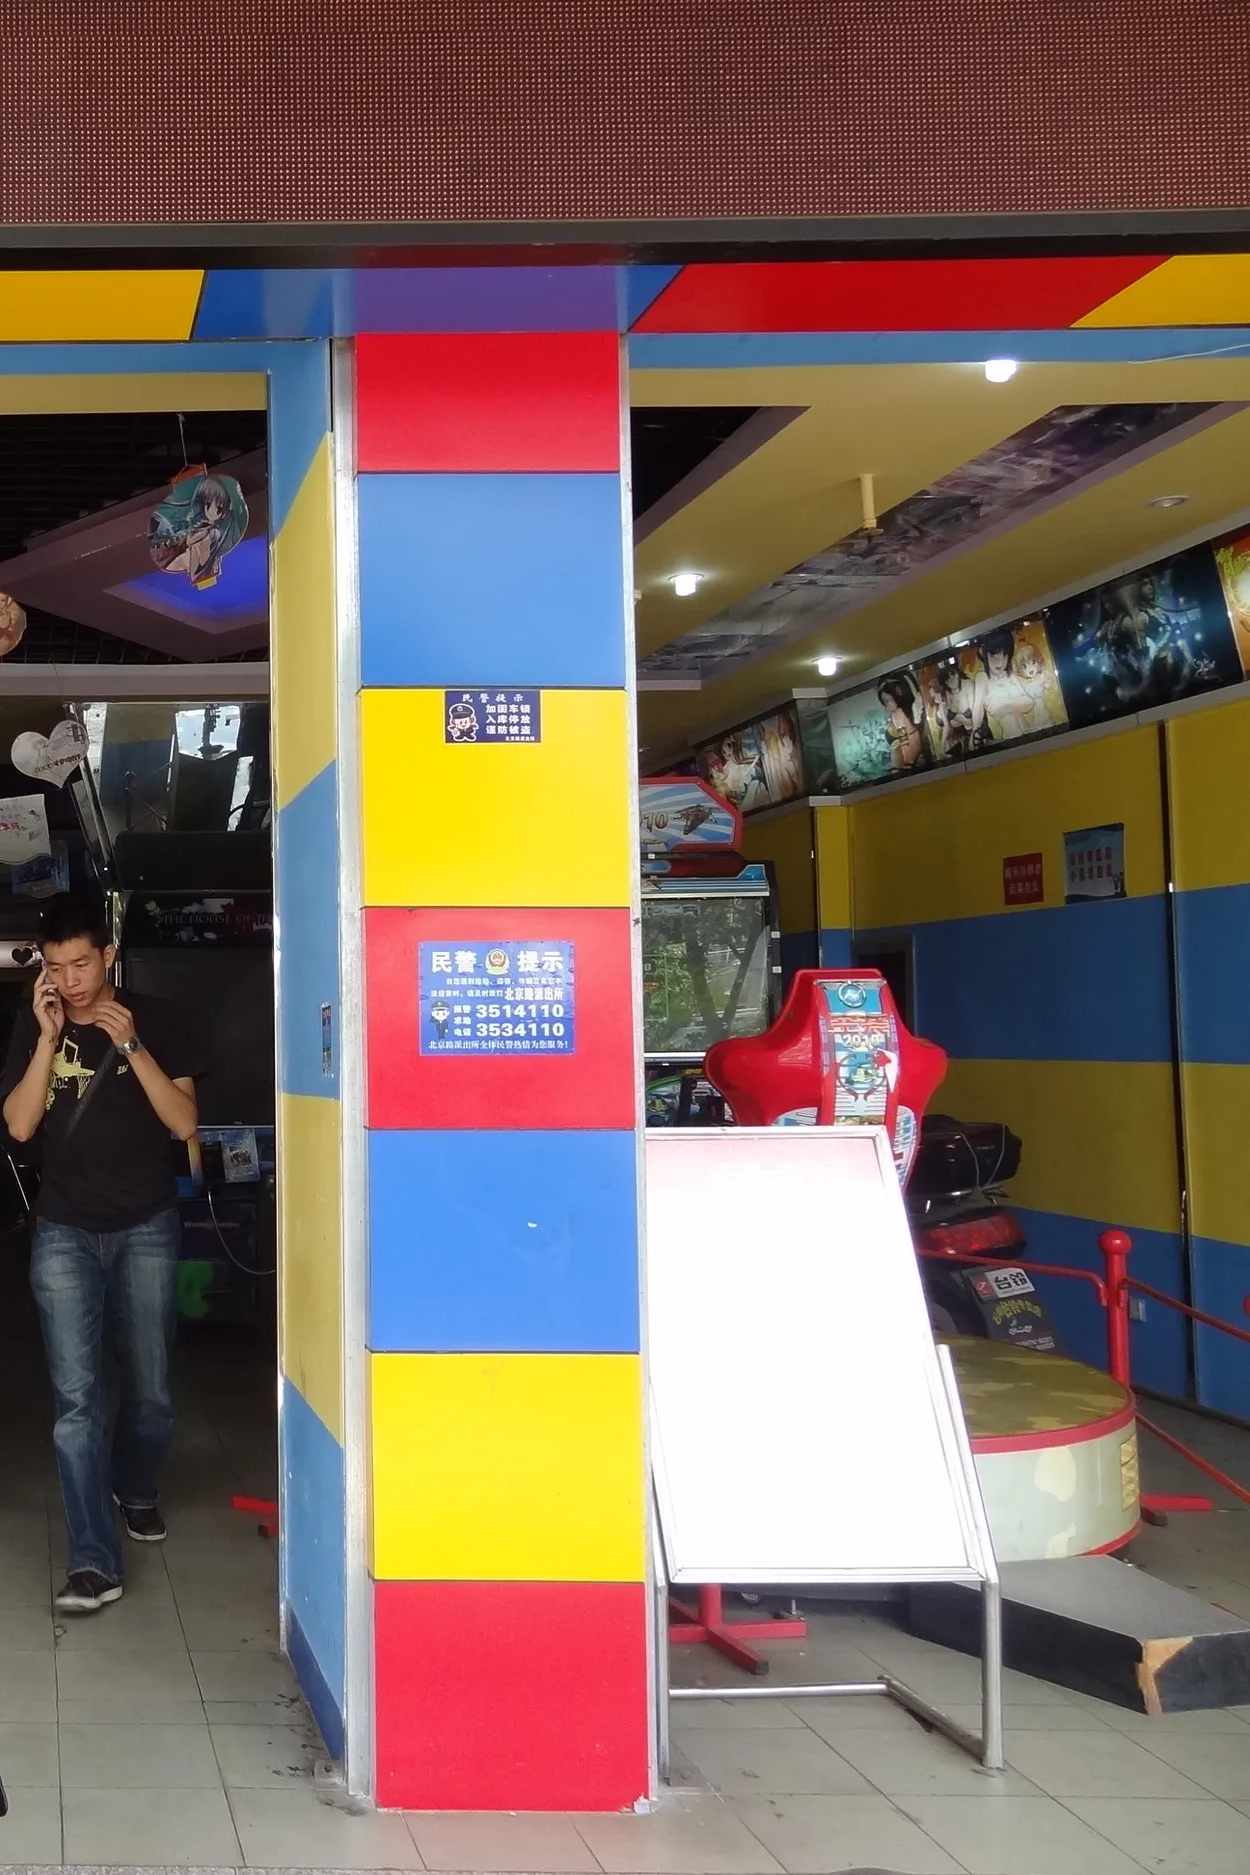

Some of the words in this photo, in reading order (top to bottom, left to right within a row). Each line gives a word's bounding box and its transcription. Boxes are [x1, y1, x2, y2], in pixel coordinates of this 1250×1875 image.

[486, 704, 531, 713] 加固车锁
[486, 715, 531, 724] 入库停放
[486, 725, 531, 735] 谨防被盗
[431, 951, 477, 973] 民警
[517, 951, 564, 973] 提示
[453, 1005, 471, 1013] 报警
[476, 1004, 565, 1018] 3514110
[453, 1028, 471, 1037] 电话
[476, 1022, 565, 1037] 3534110
[842, 1033, 880, 1048] 2010
